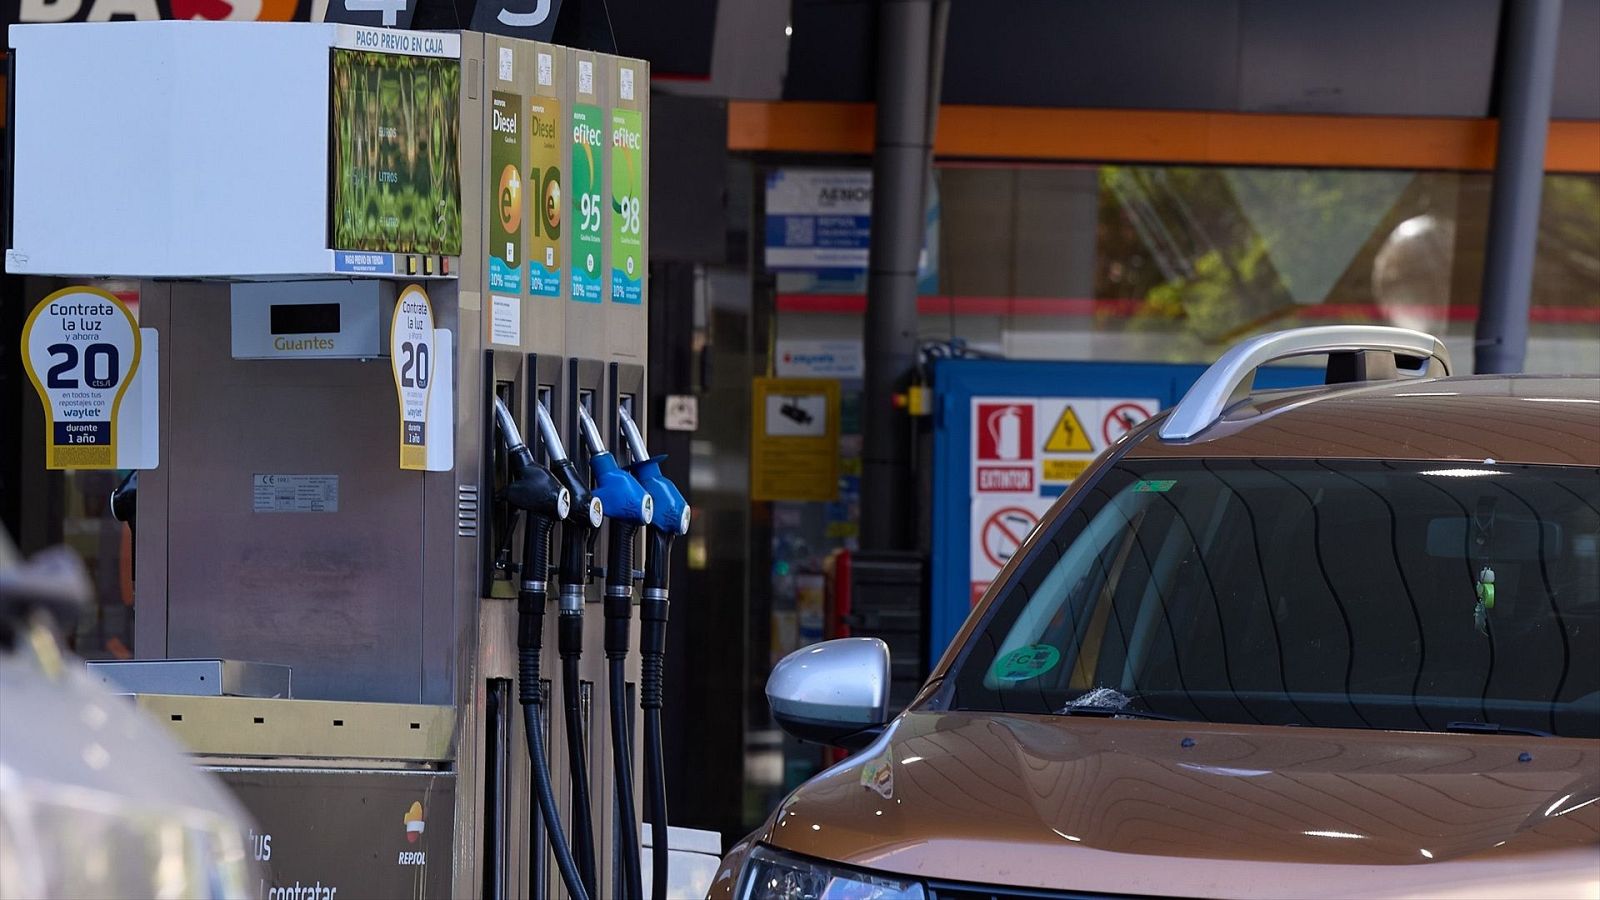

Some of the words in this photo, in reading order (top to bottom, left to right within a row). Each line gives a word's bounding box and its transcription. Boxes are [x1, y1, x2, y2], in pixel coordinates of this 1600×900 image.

[356, 31, 379, 46] PAGO
[381, 33, 409, 51] PREVIO
[411, 37, 422, 53] EN
[424, 38, 443, 54] CAJA
[493, 109, 517, 134] Diesel
[532, 115, 556, 138] Diesel
[573, 124, 601, 146] efitec
[613, 128, 640, 150] efitec
[378, 171, 398, 183] LITROS
[530, 166, 560, 241] 10
[581, 192, 600, 232] 95
[620, 195, 640, 235] 98
[490, 273, 504, 287] 10%
[572, 283, 584, 297] 10%
[50, 303, 114, 316] Contrata
[402, 301, 428, 315] Contrata
[62, 318, 76, 331] la
[80, 318, 102, 331] luz
[408, 316, 413, 329] la
[415, 317, 423, 330] luz
[274, 336, 334, 350] Guantes
[46, 343, 119, 389] 20
[402, 342, 428, 389] 20
[63, 408, 101, 418] waylet
[66, 424, 97, 432] durante
[68, 435, 73, 443] 1
[77, 433, 95, 443] año
[398, 851, 426, 865] REPSOL
